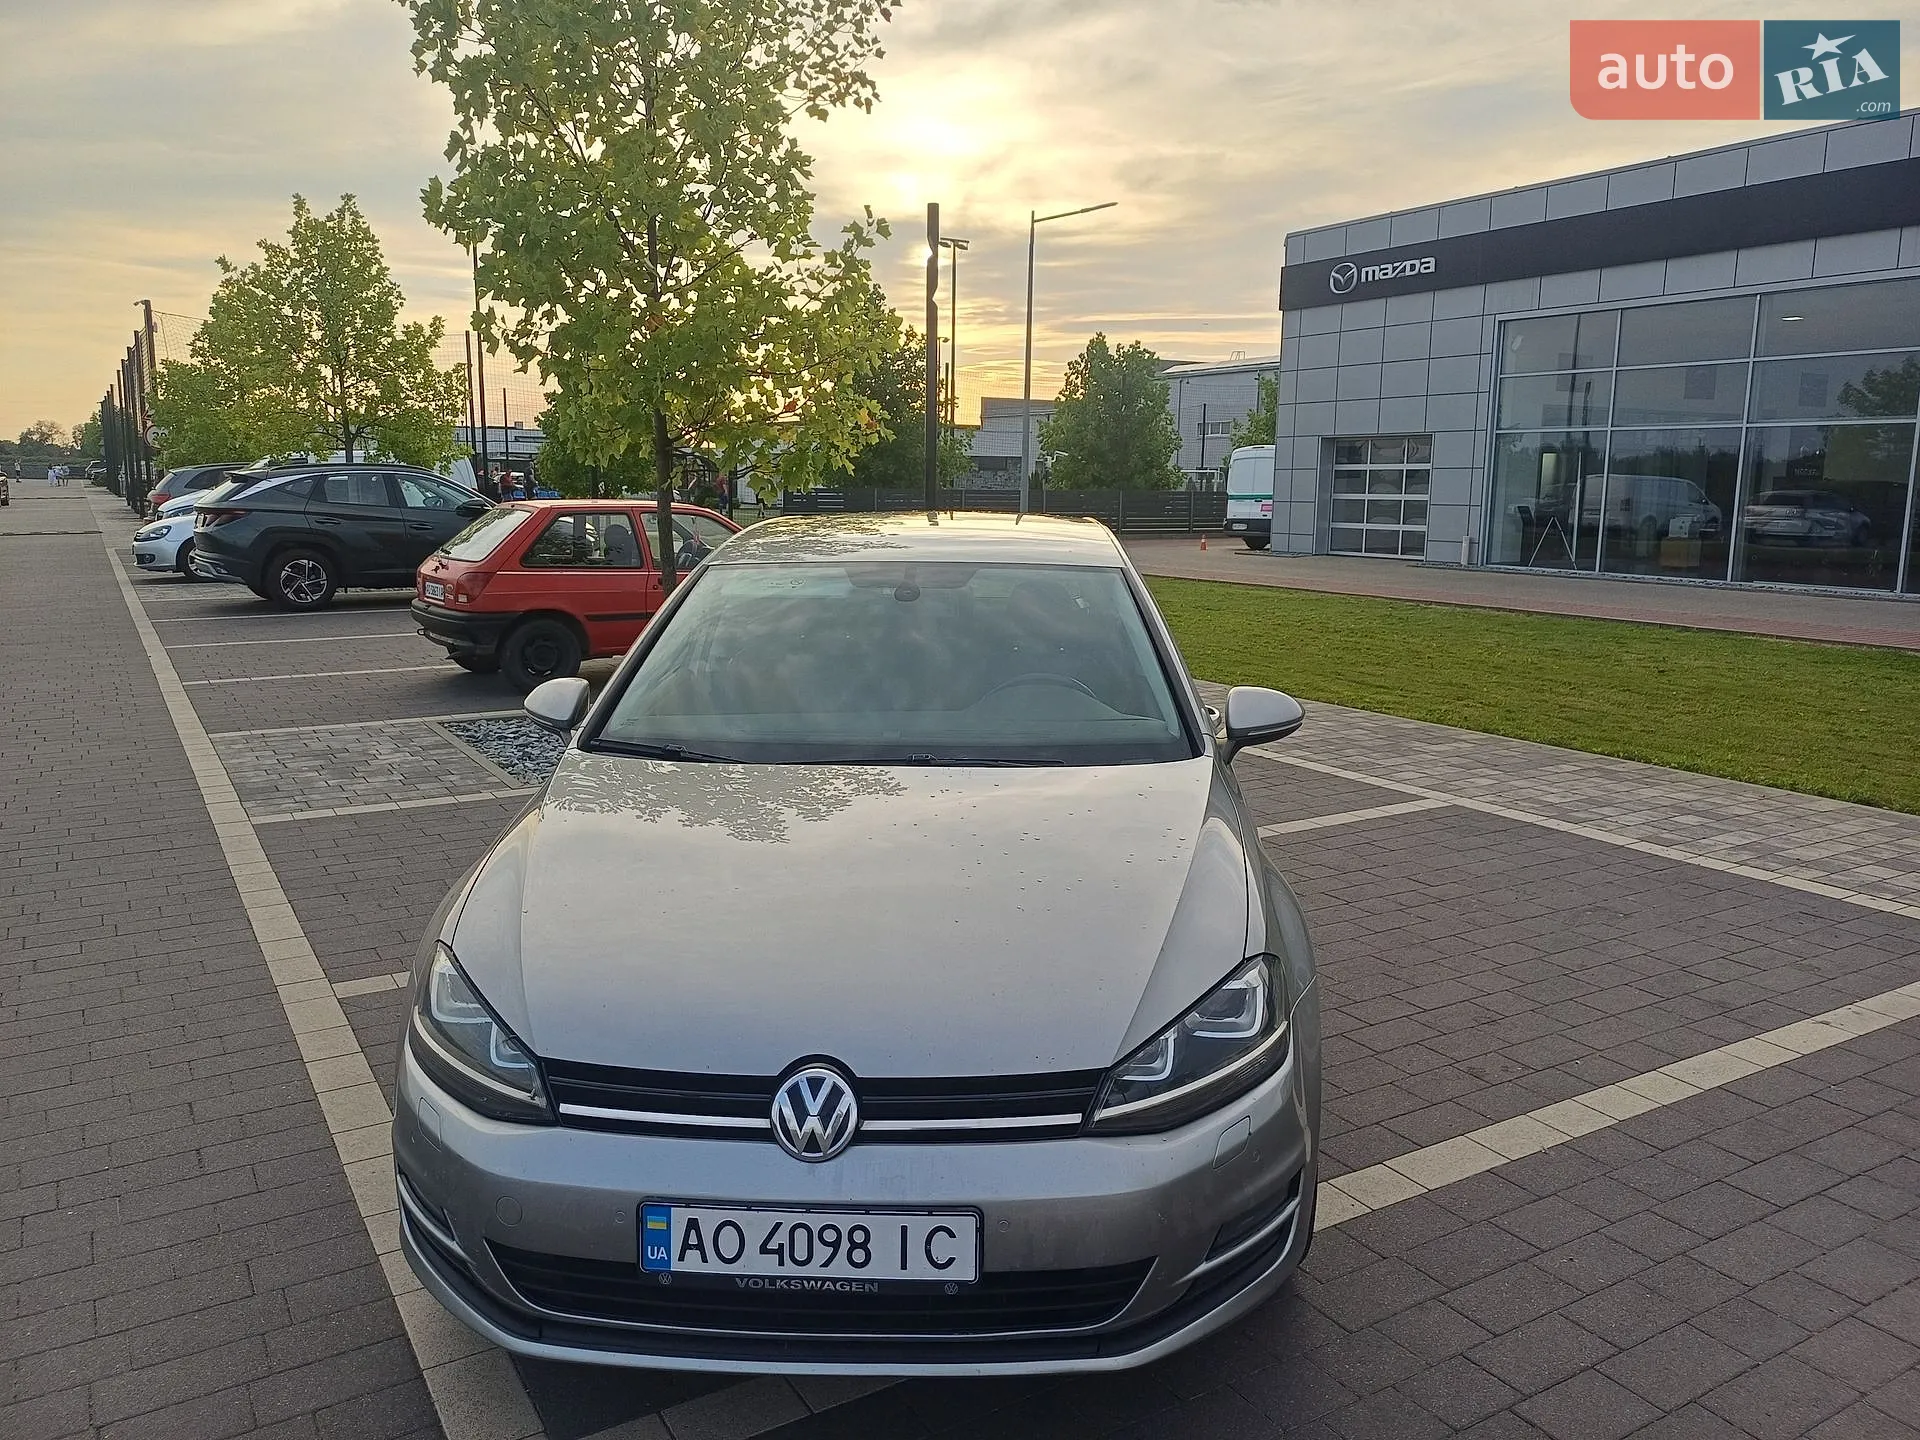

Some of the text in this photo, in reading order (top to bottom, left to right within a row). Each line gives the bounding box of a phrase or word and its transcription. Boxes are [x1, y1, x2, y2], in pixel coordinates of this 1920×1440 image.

[1361, 256, 1436, 283] mazda
[771, 1068, 858, 1163] VW
[647, 1245, 668, 1260] UA
[677, 1217, 957, 1271] AO 4098 IC
[735, 1277, 879, 1293] VOLKSWAGEN
